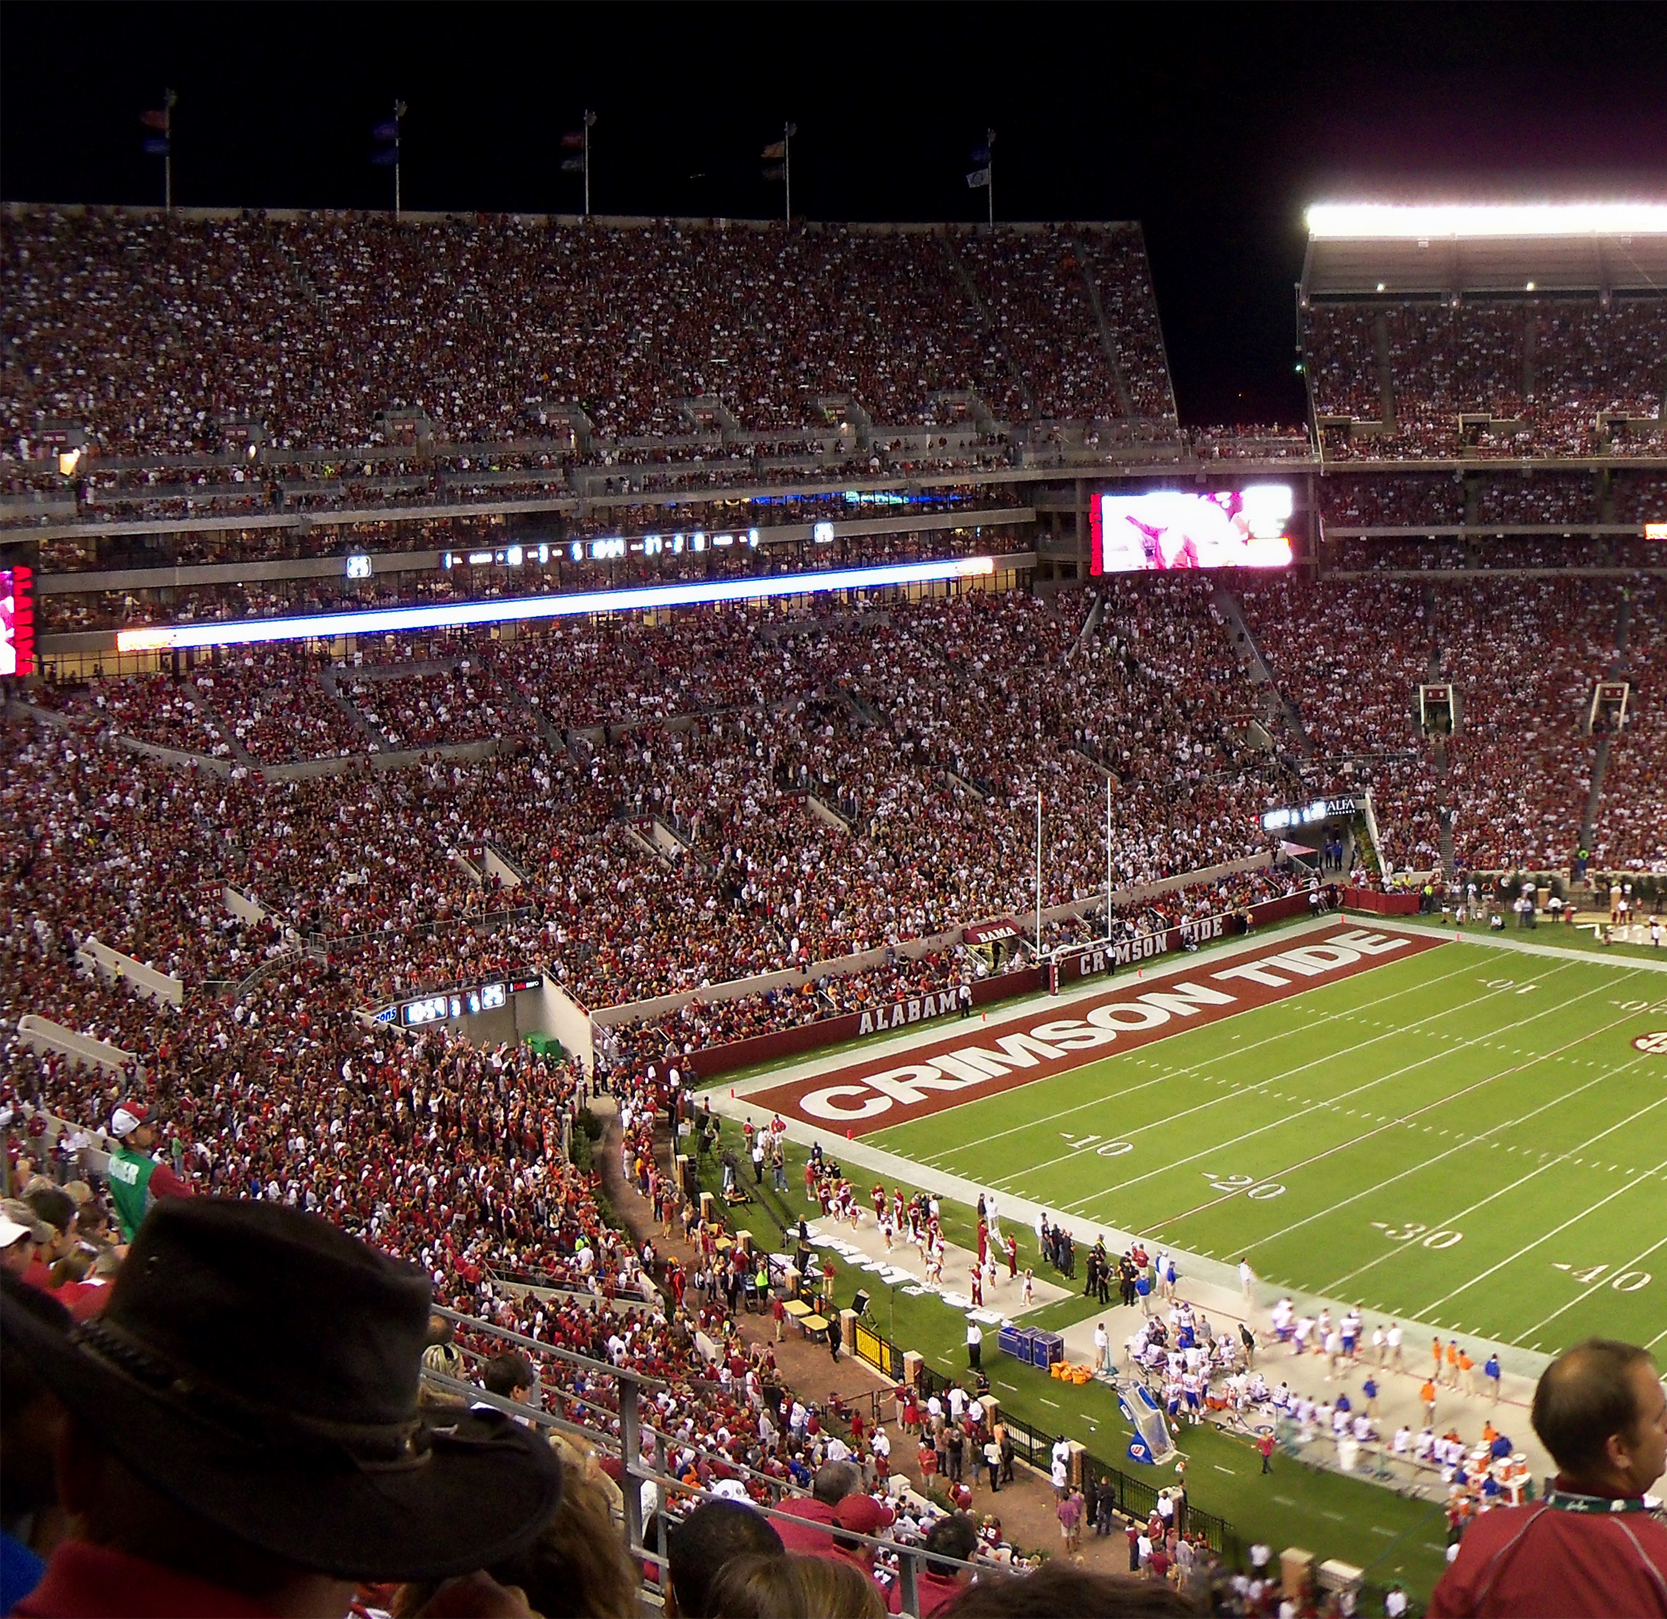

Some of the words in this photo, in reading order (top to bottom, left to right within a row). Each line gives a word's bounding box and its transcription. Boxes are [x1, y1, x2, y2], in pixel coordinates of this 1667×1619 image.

[12, 565, 34, 677] ALABAMA
[1327, 799, 1355, 812] ALFA
[976, 926, 1016, 944] BAMA
[1080, 933, 1167, 975] CRMSON
[1180, 917, 1223, 946] TIDE
[1497, 977, 1541, 995] 10
[800, 981, 1237, 1121] CRIMSON
[1210, 928, 1411, 987] TIDE
[859, 988, 974, 1035] ALABAM
[1072, 1134, 1134, 1157] 10
[1217, 1174, 1286, 1200] 20
[1389, 1222, 1464, 1250] 30
[1569, 1262, 1652, 1291] 40
